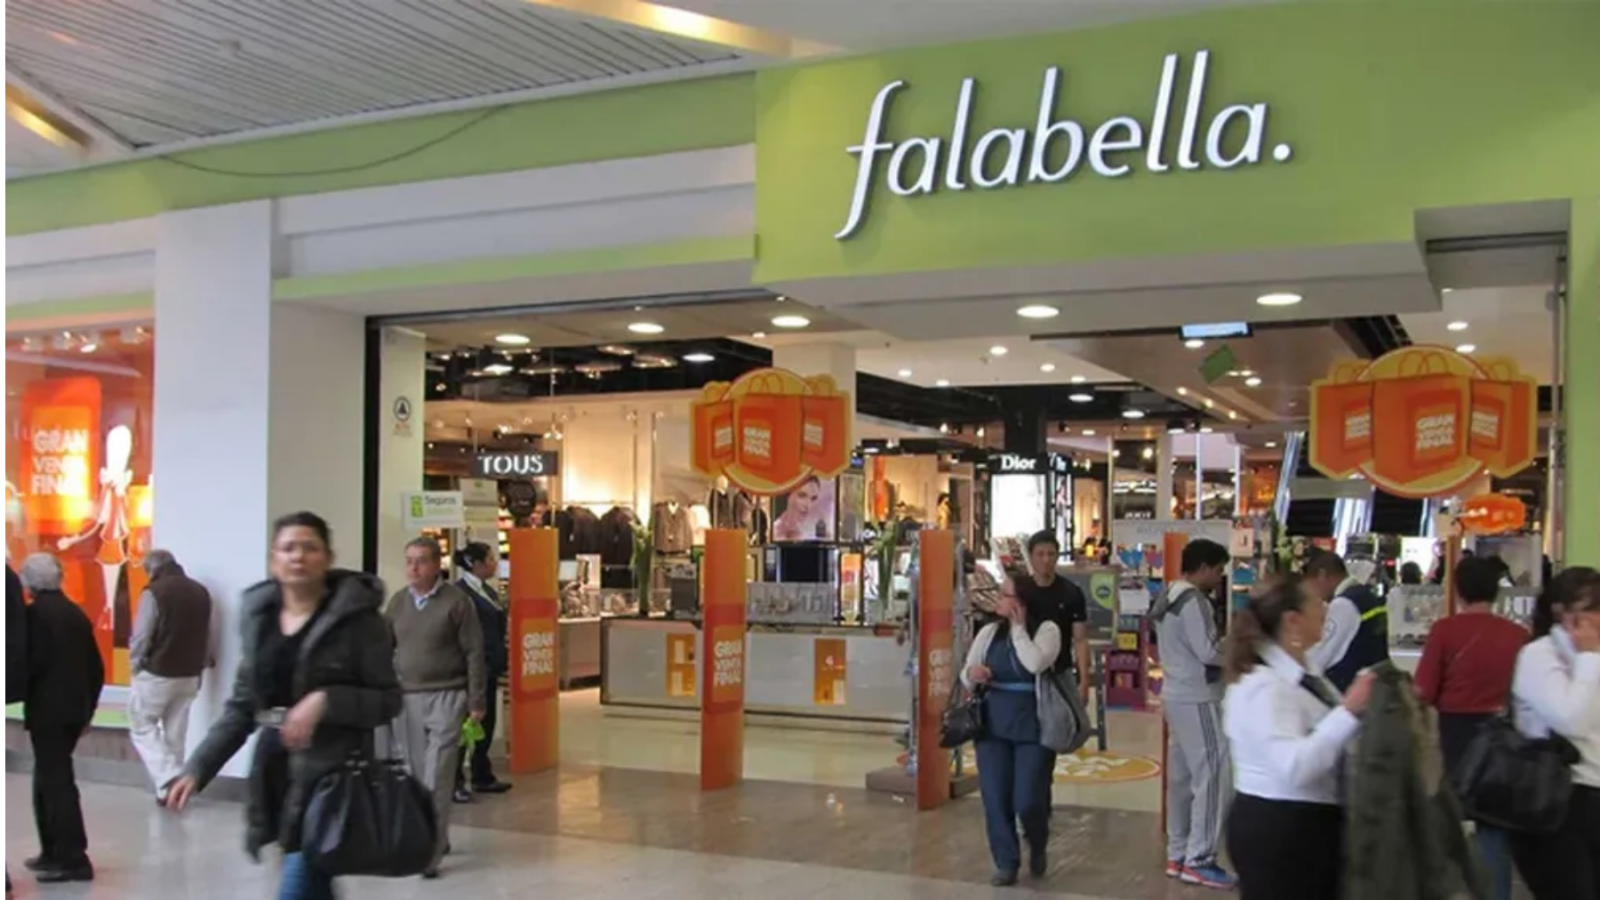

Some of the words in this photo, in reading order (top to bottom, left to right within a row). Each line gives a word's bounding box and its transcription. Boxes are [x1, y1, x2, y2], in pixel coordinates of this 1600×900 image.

[834, 49, 1293, 241] falabella.
[33, 429, 87, 452] GRAN
[478, 455, 543, 474] TOUS
[1001, 454, 1036, 470] Dior
